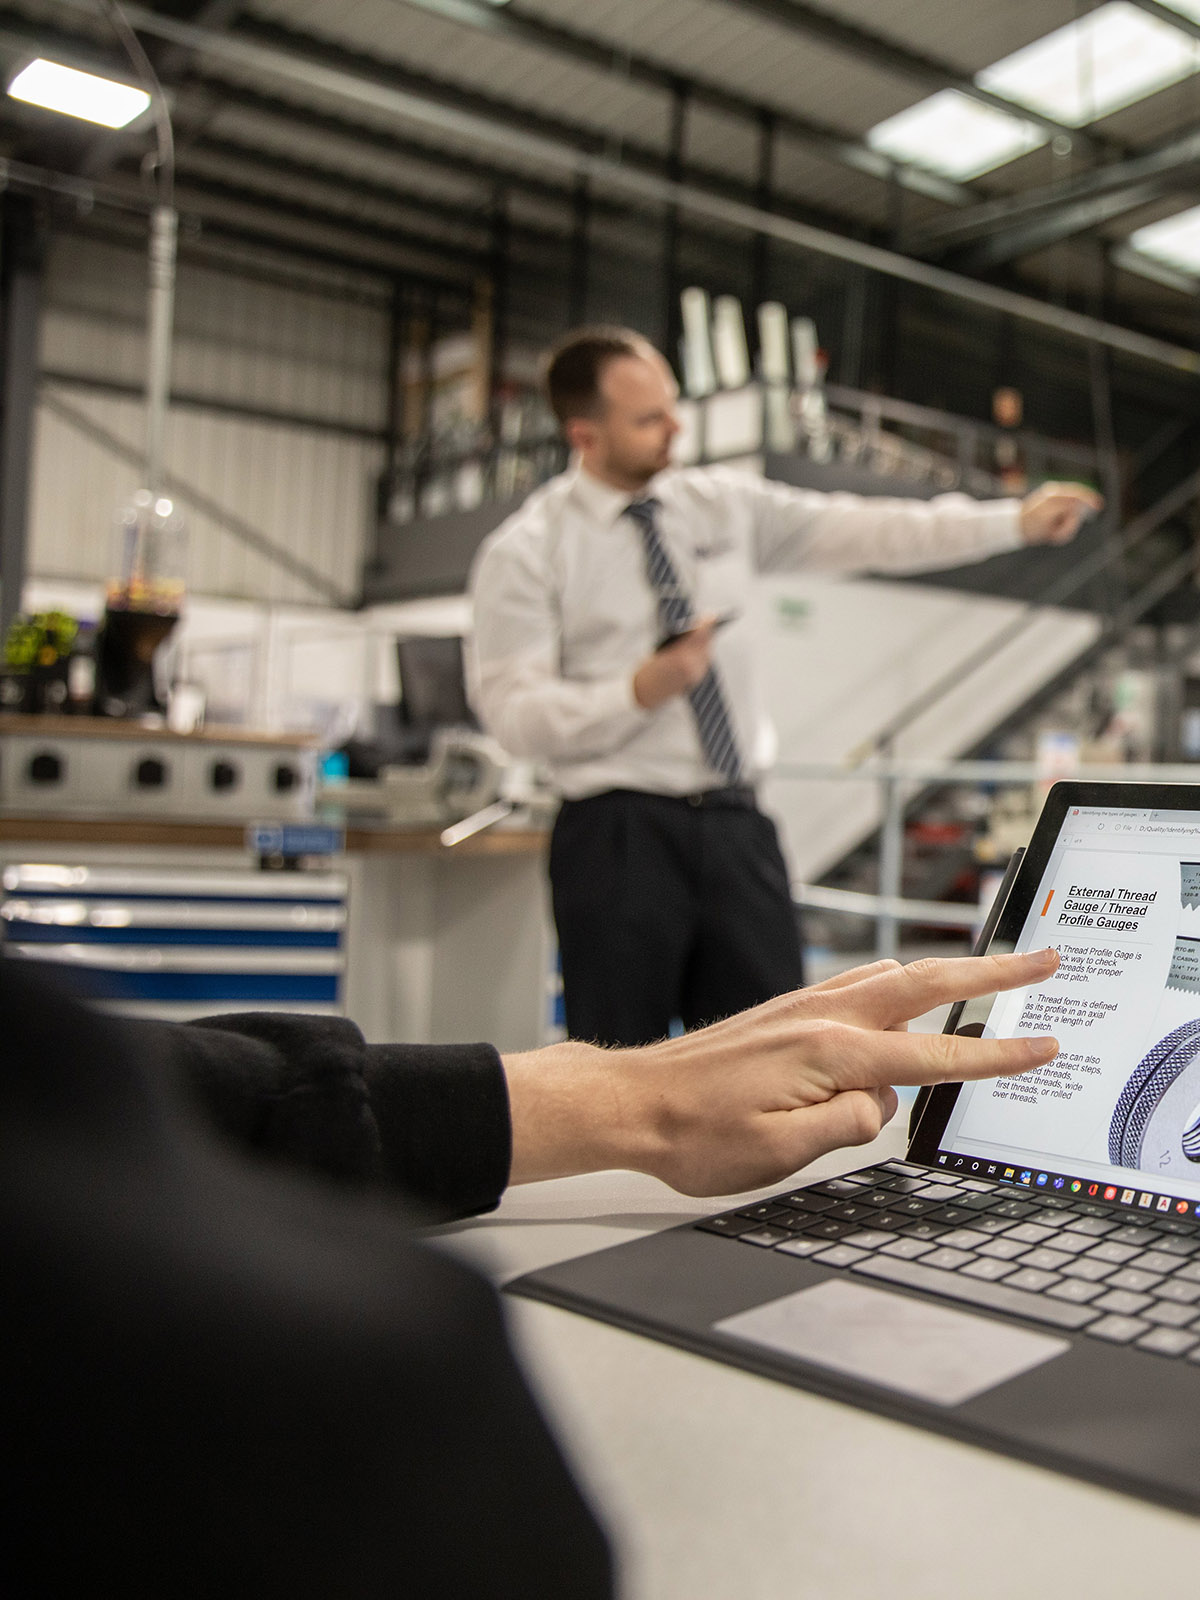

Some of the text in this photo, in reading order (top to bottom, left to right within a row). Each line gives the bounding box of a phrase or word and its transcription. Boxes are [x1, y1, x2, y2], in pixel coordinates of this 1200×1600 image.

[1068, 886, 1157, 901] External Thread
[1064, 900, 1148, 915] Gauge / Thread
[1058, 913, 1139, 931] Profile Gauges
[1060, 954, 1070, 962] ick
[1071, 956, 1084, 965] way
[1094, 958, 1117, 966] check
[1063, 945, 1088, 955] Thread
[1089, 947, 1112, 957] Profile
[1114, 950, 1133, 960] Gage
[1055, 972, 1070, 980] and
[1070, 974, 1090, 982] pitch.
[1058, 963, 1123, 977] threads for proper
[1035, 1002, 1044, 1011] its
[1044, 1004, 1067, 1014] profile
[1069, 1007, 1076, 1016] in
[1077, 1009, 1087, 1017] an
[1088, 1010, 1106, 1019] axial
[1037, 994, 1118, 1012] Thread form is defined
[1018, 1020, 1053, 1032] one pitch.
[1021, 1011, 1042, 1020] plane
[1042, 1012, 1053, 1022] for
[1060, 1016, 1083, 1027] length
[1085, 1018, 1094, 1027] of
[1069, 1053, 1083, 1061] can
[1084, 1055, 1101, 1064] also
[1043, 1069, 1072, 1080] threads,
[1056, 1060, 1079, 1071] detect
[1080, 1065, 1102, 1075] steps,
[996, 1080, 1010, 1089] first
[1010, 1082, 1039, 1095] threads,
[1050, 1089, 1073, 1099] rolled
[1034, 1077, 1062, 1088] threads,
[1065, 1082, 1083, 1091] wide
[992, 1090, 1038, 1104] over threads.
[1160, 1150, 1171, 1168] 12
